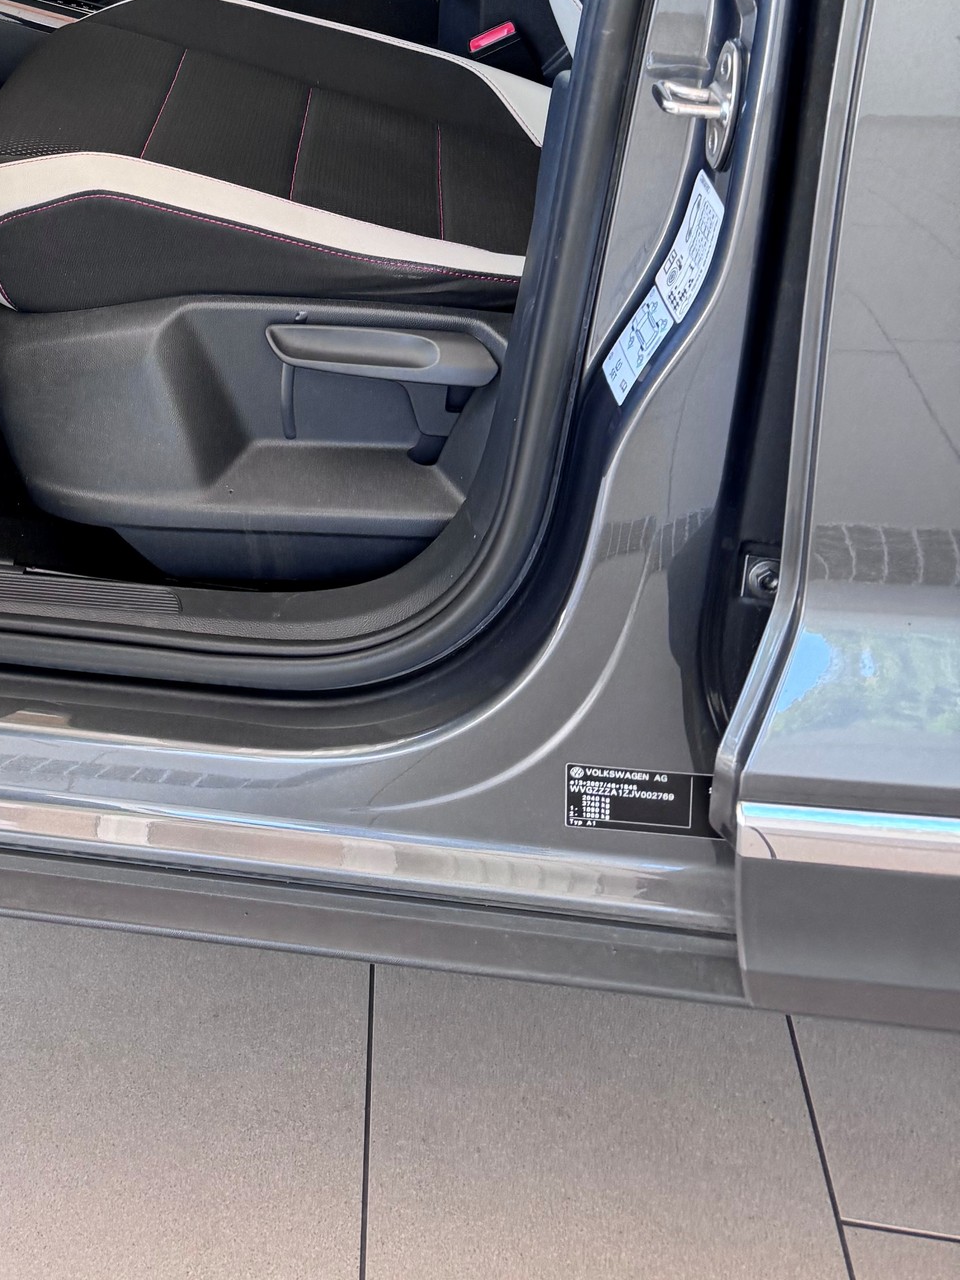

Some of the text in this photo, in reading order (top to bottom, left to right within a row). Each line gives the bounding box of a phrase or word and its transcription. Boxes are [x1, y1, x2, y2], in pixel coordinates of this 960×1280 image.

[586, 768, 668, 782] VOLKSWAGEN AG
[582, 794, 610, 804] 2040 kg
[570, 818, 582, 826] Typ
